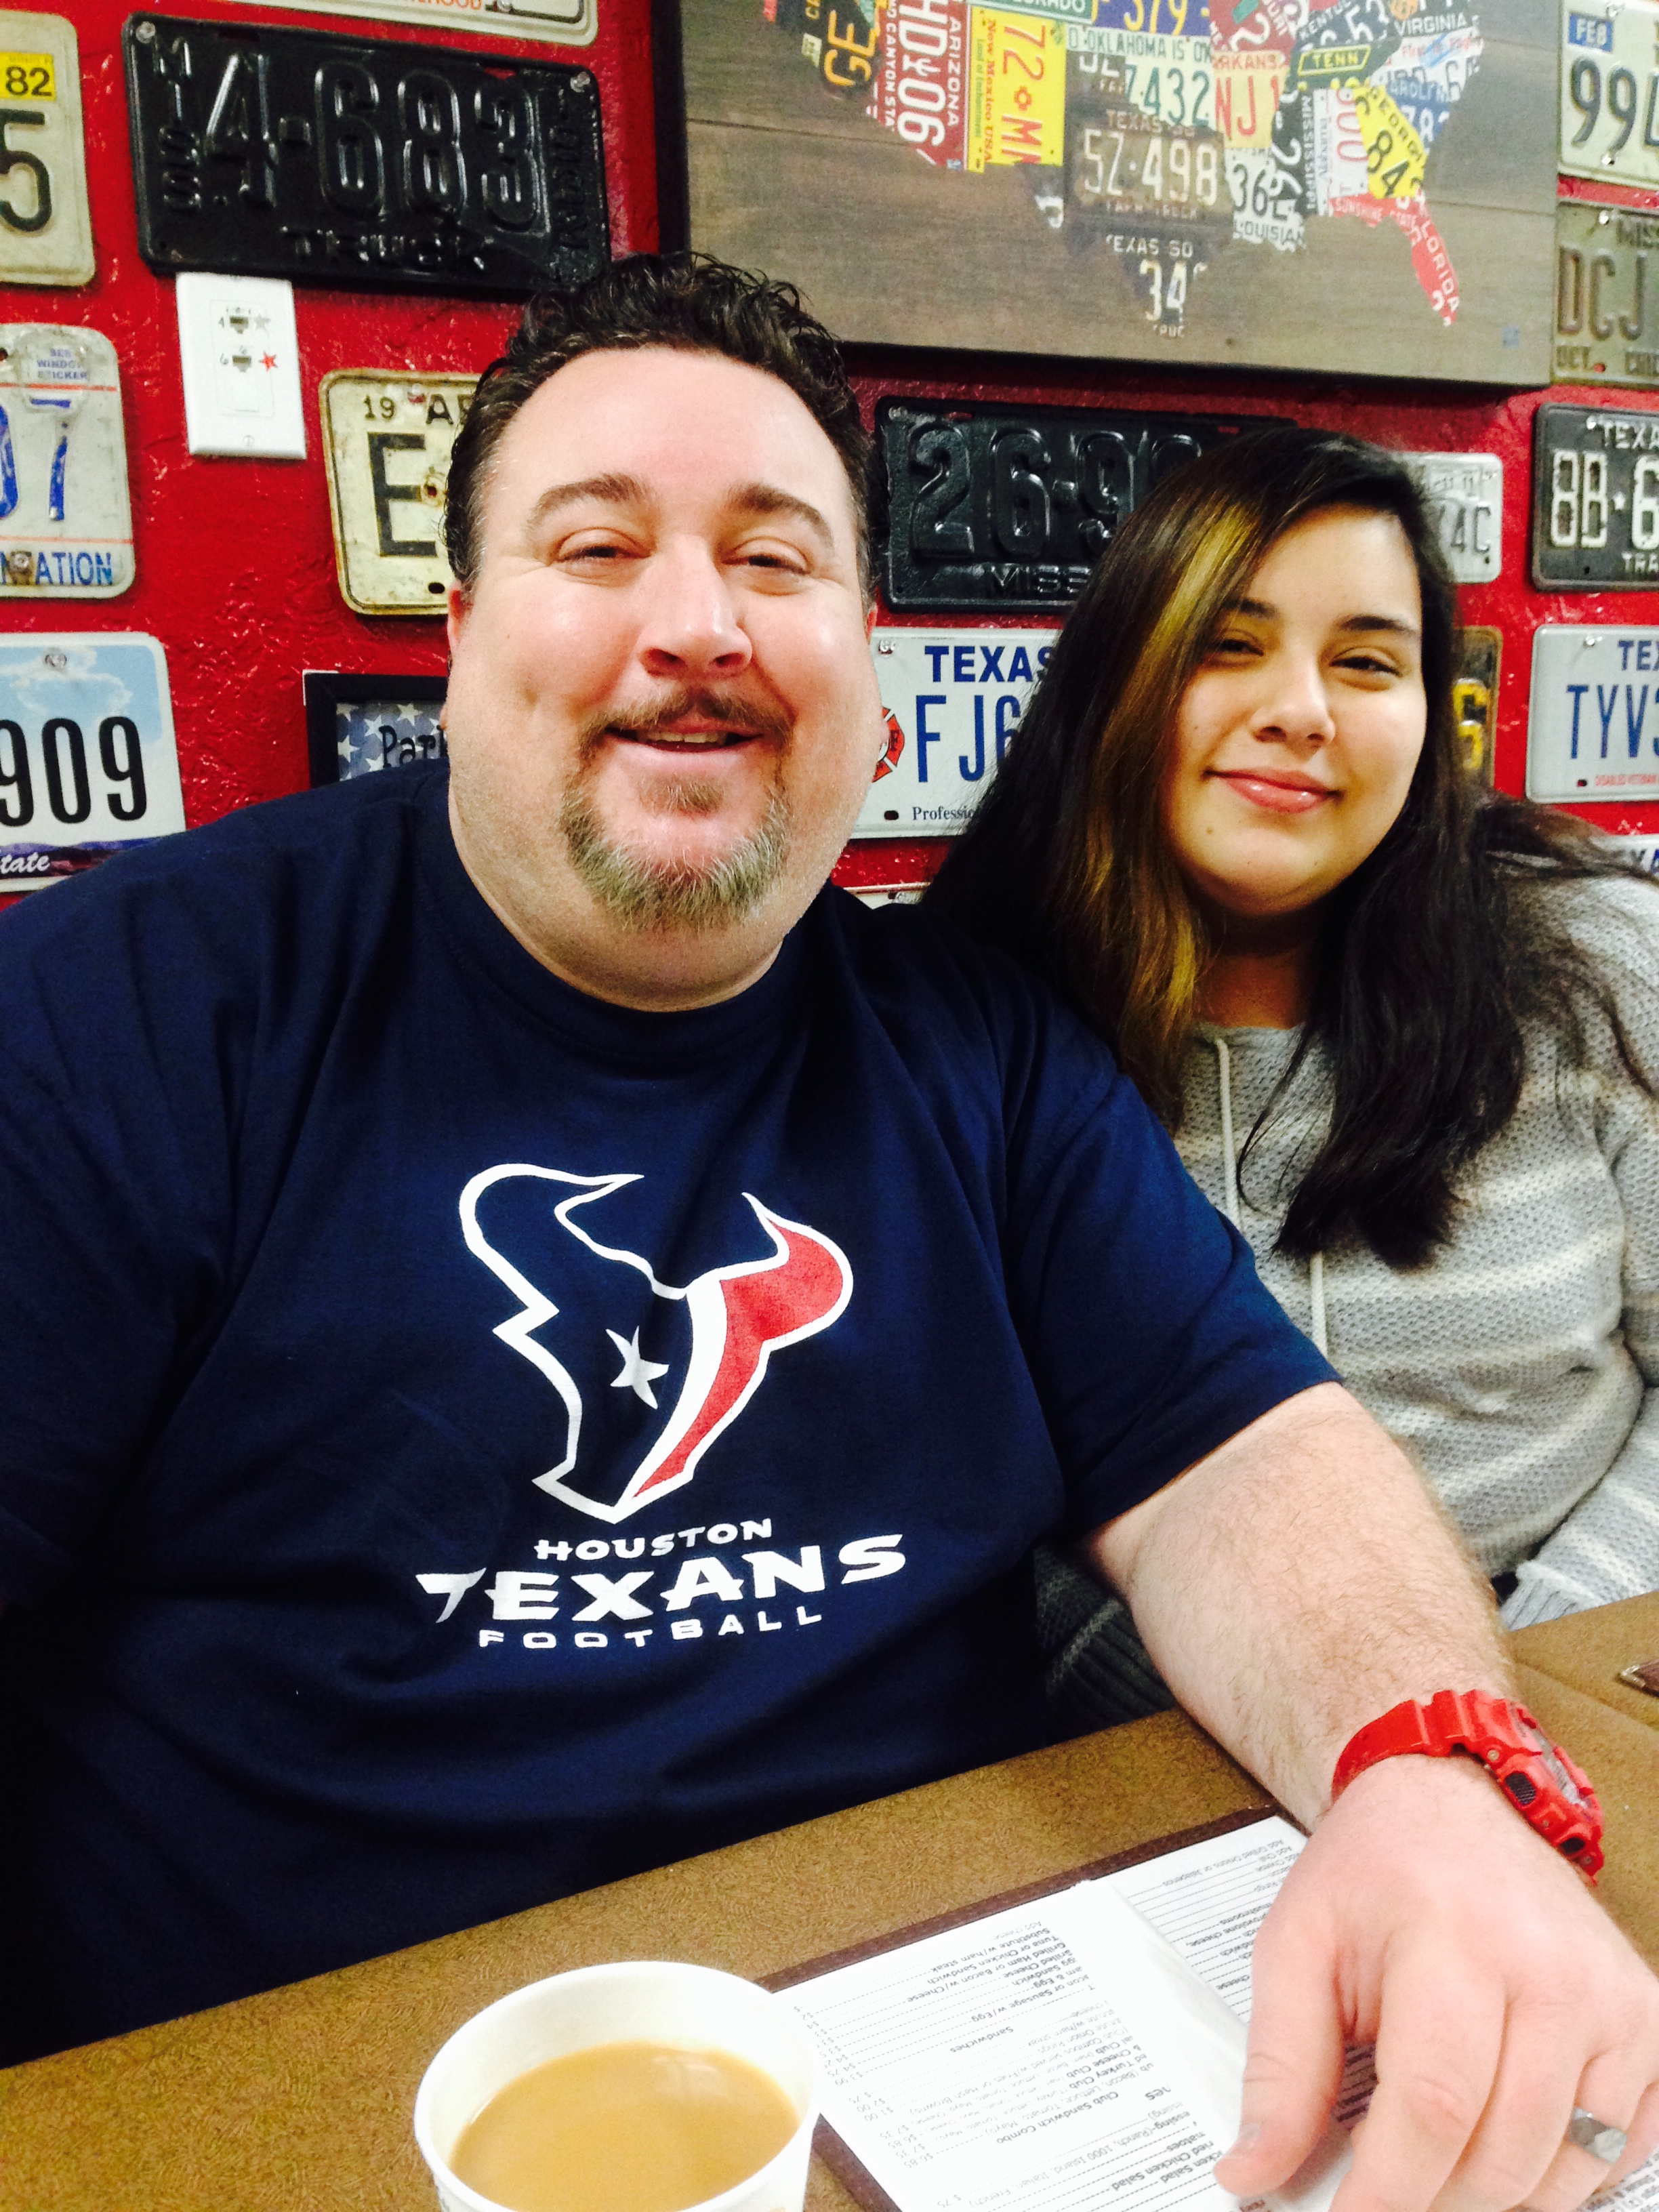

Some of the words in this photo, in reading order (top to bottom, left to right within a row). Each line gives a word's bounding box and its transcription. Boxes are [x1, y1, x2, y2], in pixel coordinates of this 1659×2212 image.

[1393, 12, 1469, 35] VIRGINIA
[1576, 18, 1607, 46] FEB
[1086, 31, 1167, 58] OKLAHOMA
[1312, 52, 1359, 69] TENN
[5, 66, 52, 96] 82
[947, 16, 962, 127] ARIZONA
[985, 60, 996, 121] Mexico
[363, 394, 396, 421] 19
[367, 431, 438, 558] E
[1618, 640, 1659, 671] TE
[0, 716, 147, 827] 909
[533, 1518, 772, 1561] HOUSTON
[415, 1533, 907, 1624] TEXANS
[478, 1605, 823, 1650] FOOTBALL
[998, 1927, 1050, 1948] Substitute
[1031, 1934, 1059, 1947] Tuna
[978, 1949, 1019, 1965] Chicken
[1019, 1944, 1031, 1952] or
[1031, 1940, 1066, 1959] Grilled
[1039, 1948, 1073, 1966] Grilled
[930, 1959, 958, 1973] steak
[1002, 1962, 1040, 1978] Cheese
[1006, 1954, 1032, 1966] Ham
[926, 1963, 977, 1984] Sandwich
[960, 1968, 993, 1983] Bacon
[1011, 1964, 1061, 1986] Sandwich
[1032, 1977, 1055, 1988] Egg
[1008, 1988, 1053, 2008] Sausage
[1054, 1984, 1065, 1992] or
[949, 2026, 1013, 2053] Sandwiches
[1094, 2041, 1120, 2054] Club
[1092, 2049, 1131, 2067] Cheese
[1065, 2064, 1092, 2078] Club
[1095, 2060, 1134, 2078] Turkey
[1068, 2075, 1094, 2089] Club
[1092, 2091, 1119, 2105] Club
[1037, 2102, 1092, 2127] Sandwich
[996, 2125, 1036, 2144] Combo
[1086, 2144, 1113, 2160] 1000
[1144, 2151, 1191, 2175] Chicken
[1110, 2171, 1145, 2192] Salad
[1159, 2164, 1193, 2184] Salad
[968, 2188, 1011, 2207] French)
